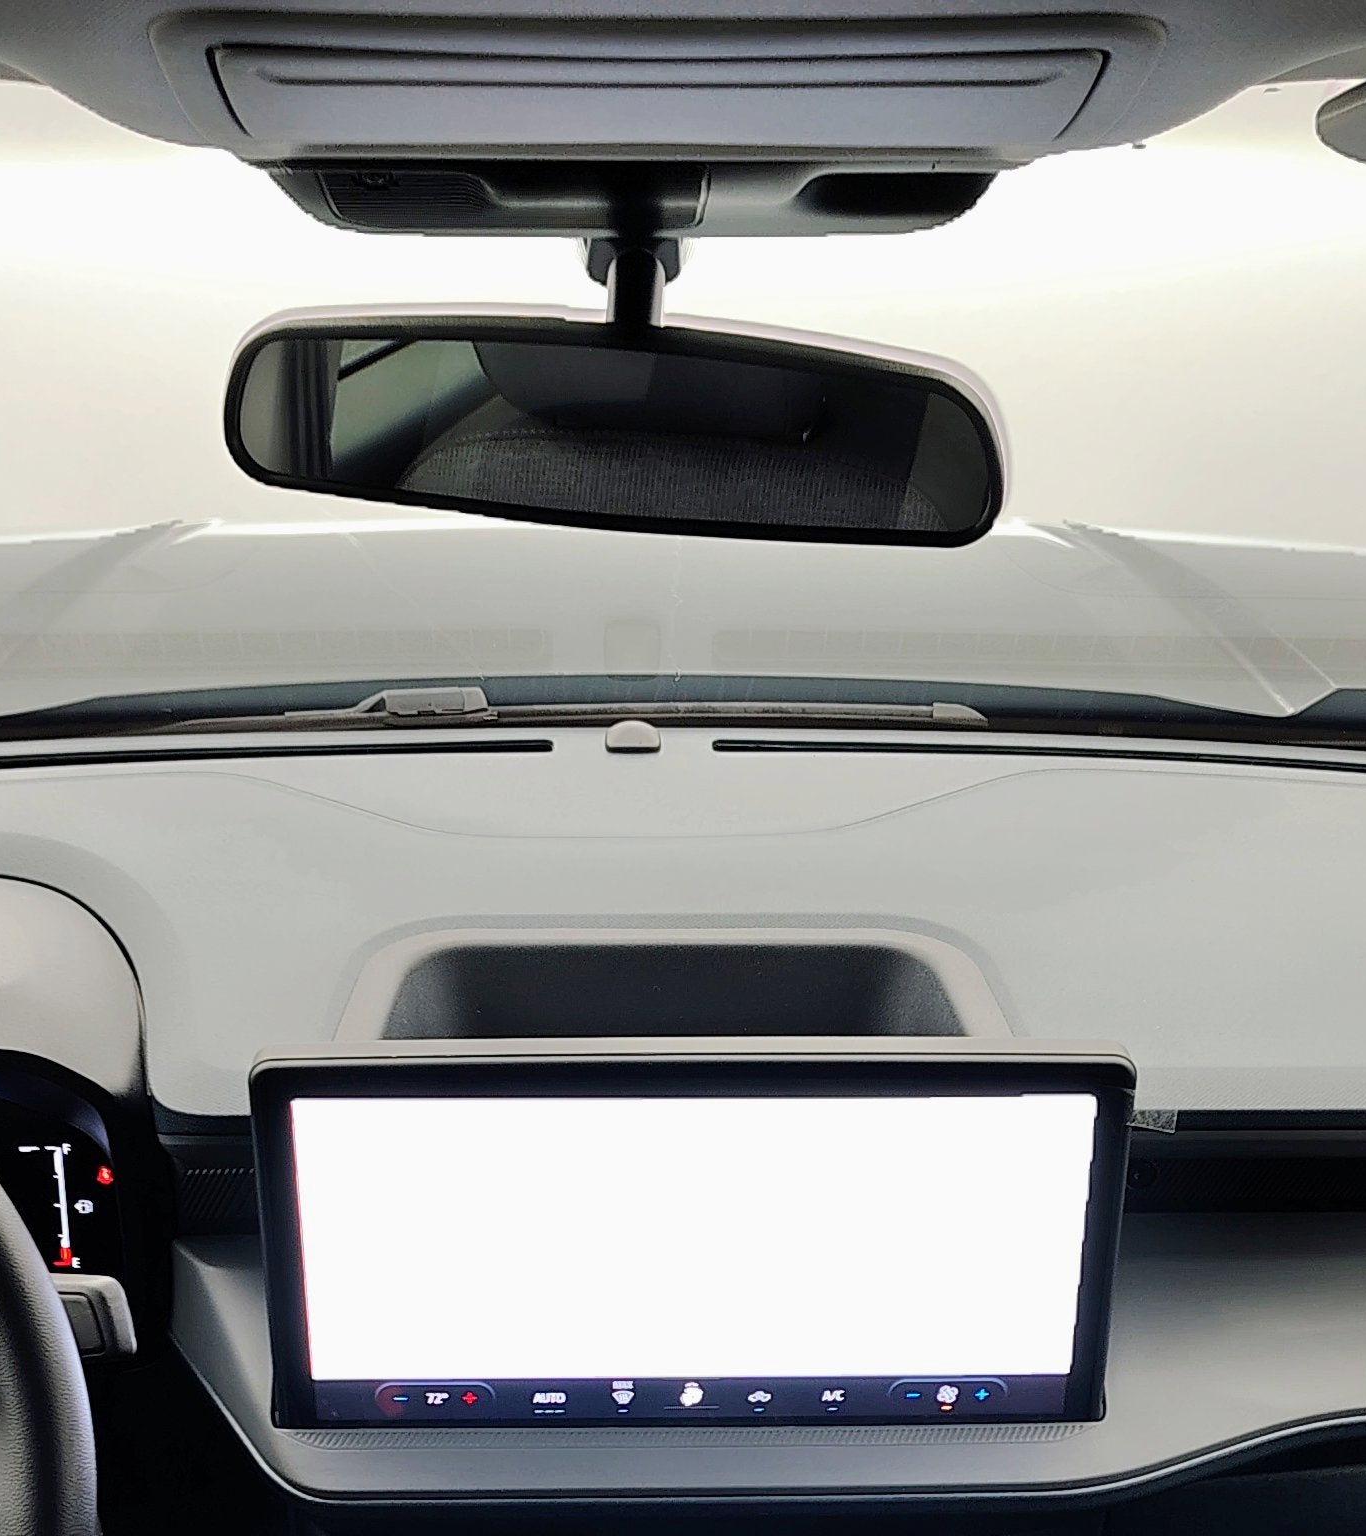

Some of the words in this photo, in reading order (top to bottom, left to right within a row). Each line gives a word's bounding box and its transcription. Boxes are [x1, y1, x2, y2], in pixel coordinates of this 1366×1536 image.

[61, 1142, 72, 1155] F
[71, 1256, 81, 1269] E
[532, 1392, 567, 1404] AUTO
[821, 1389, 846, 1402] A/C
